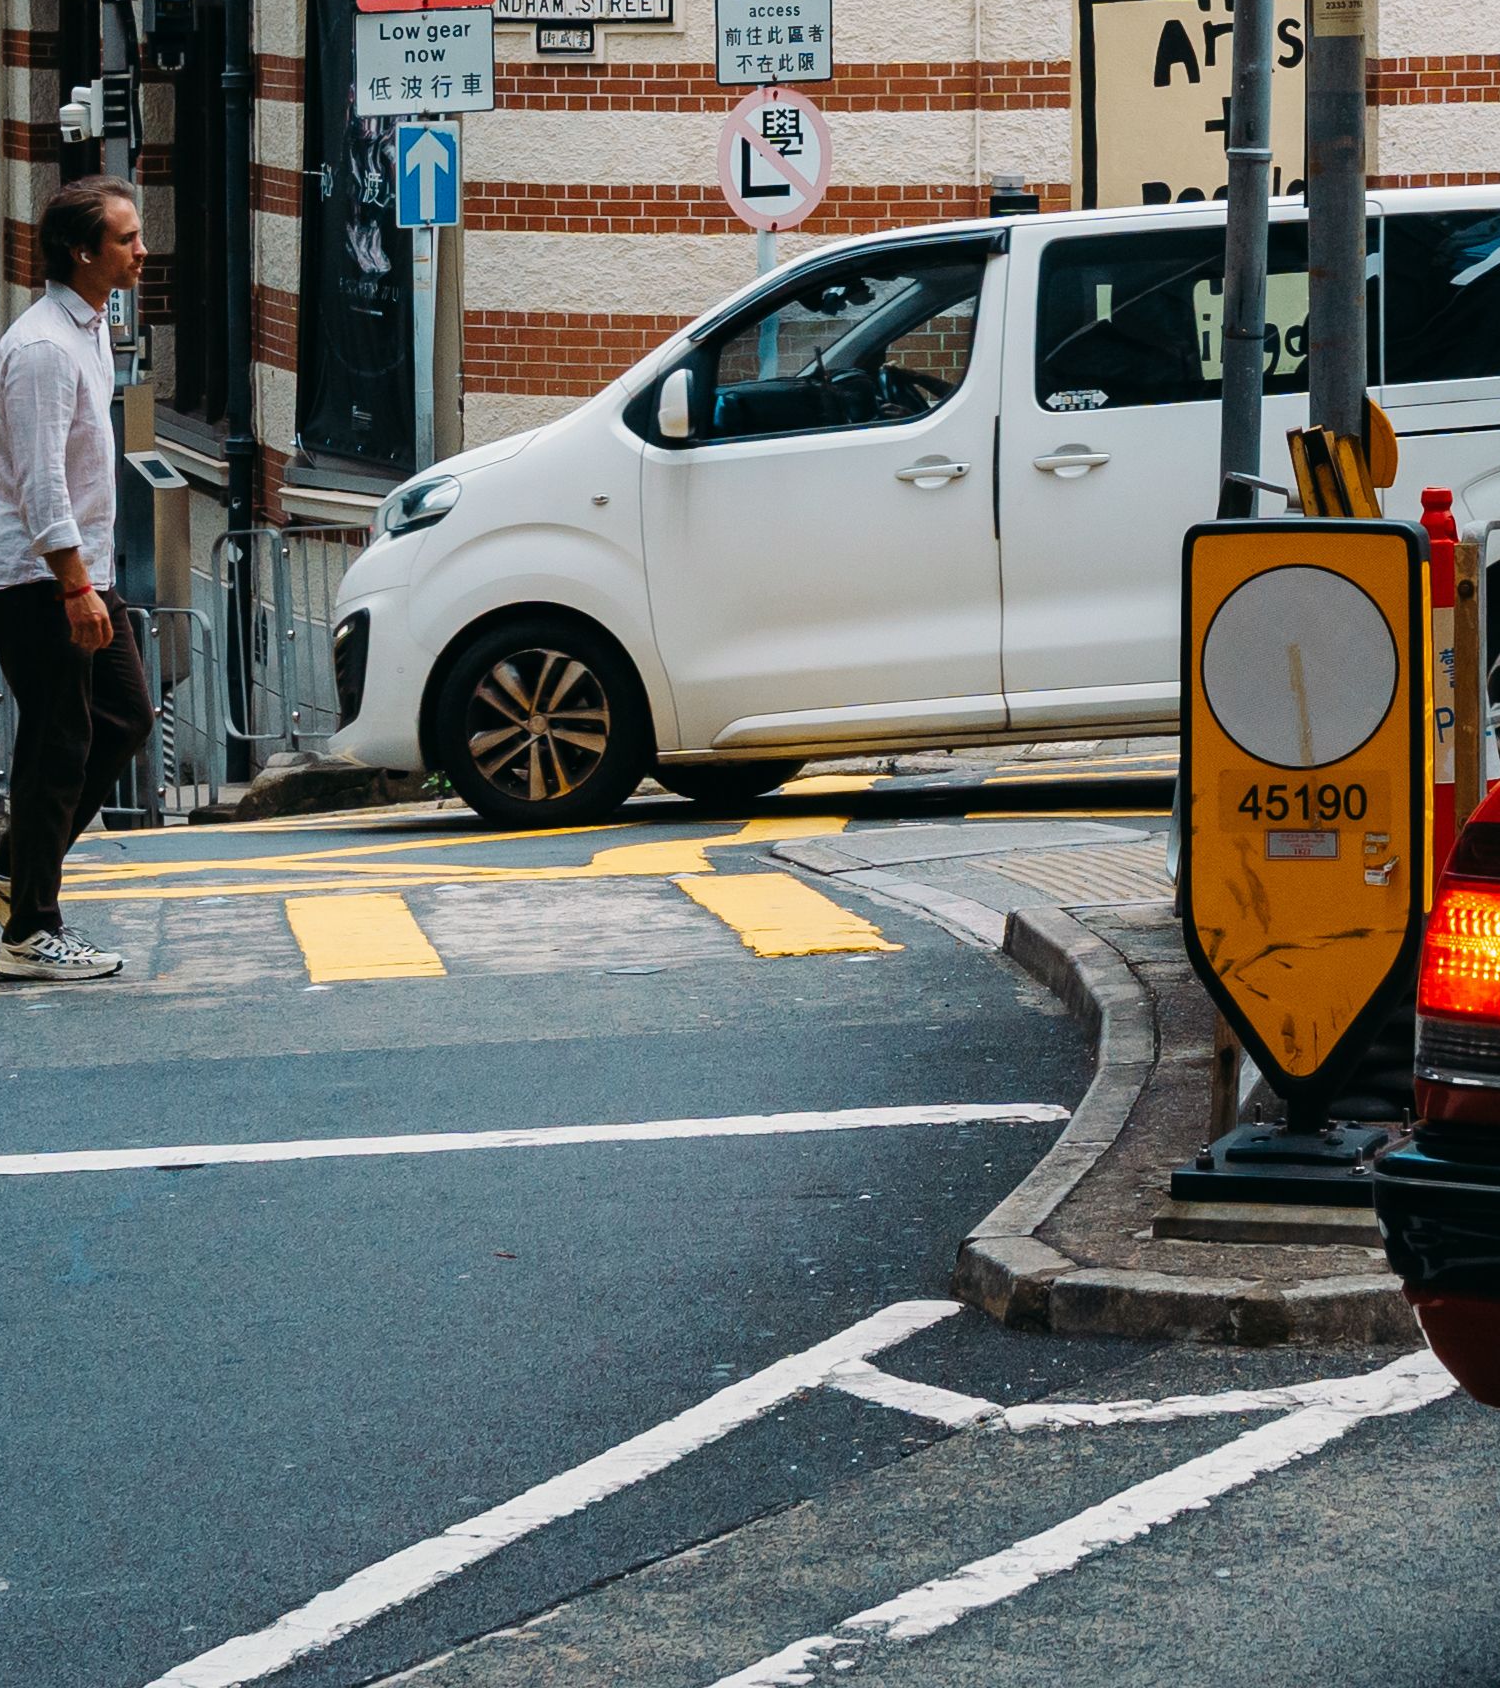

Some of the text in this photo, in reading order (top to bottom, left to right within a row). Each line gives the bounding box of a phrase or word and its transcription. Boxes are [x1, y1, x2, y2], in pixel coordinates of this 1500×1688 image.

[749, 4, 801, 18] access
[379, 21, 471, 46] Low gear
[725, 24, 825, 47] 前往此區者
[404, 48, 446, 63] now
[736, 52, 815, 74] 不在此限
[1154, 17, 1304, 88] Ars
[368, 73, 483, 101] 低波行車
[1238, 784, 1368, 821] 45190
